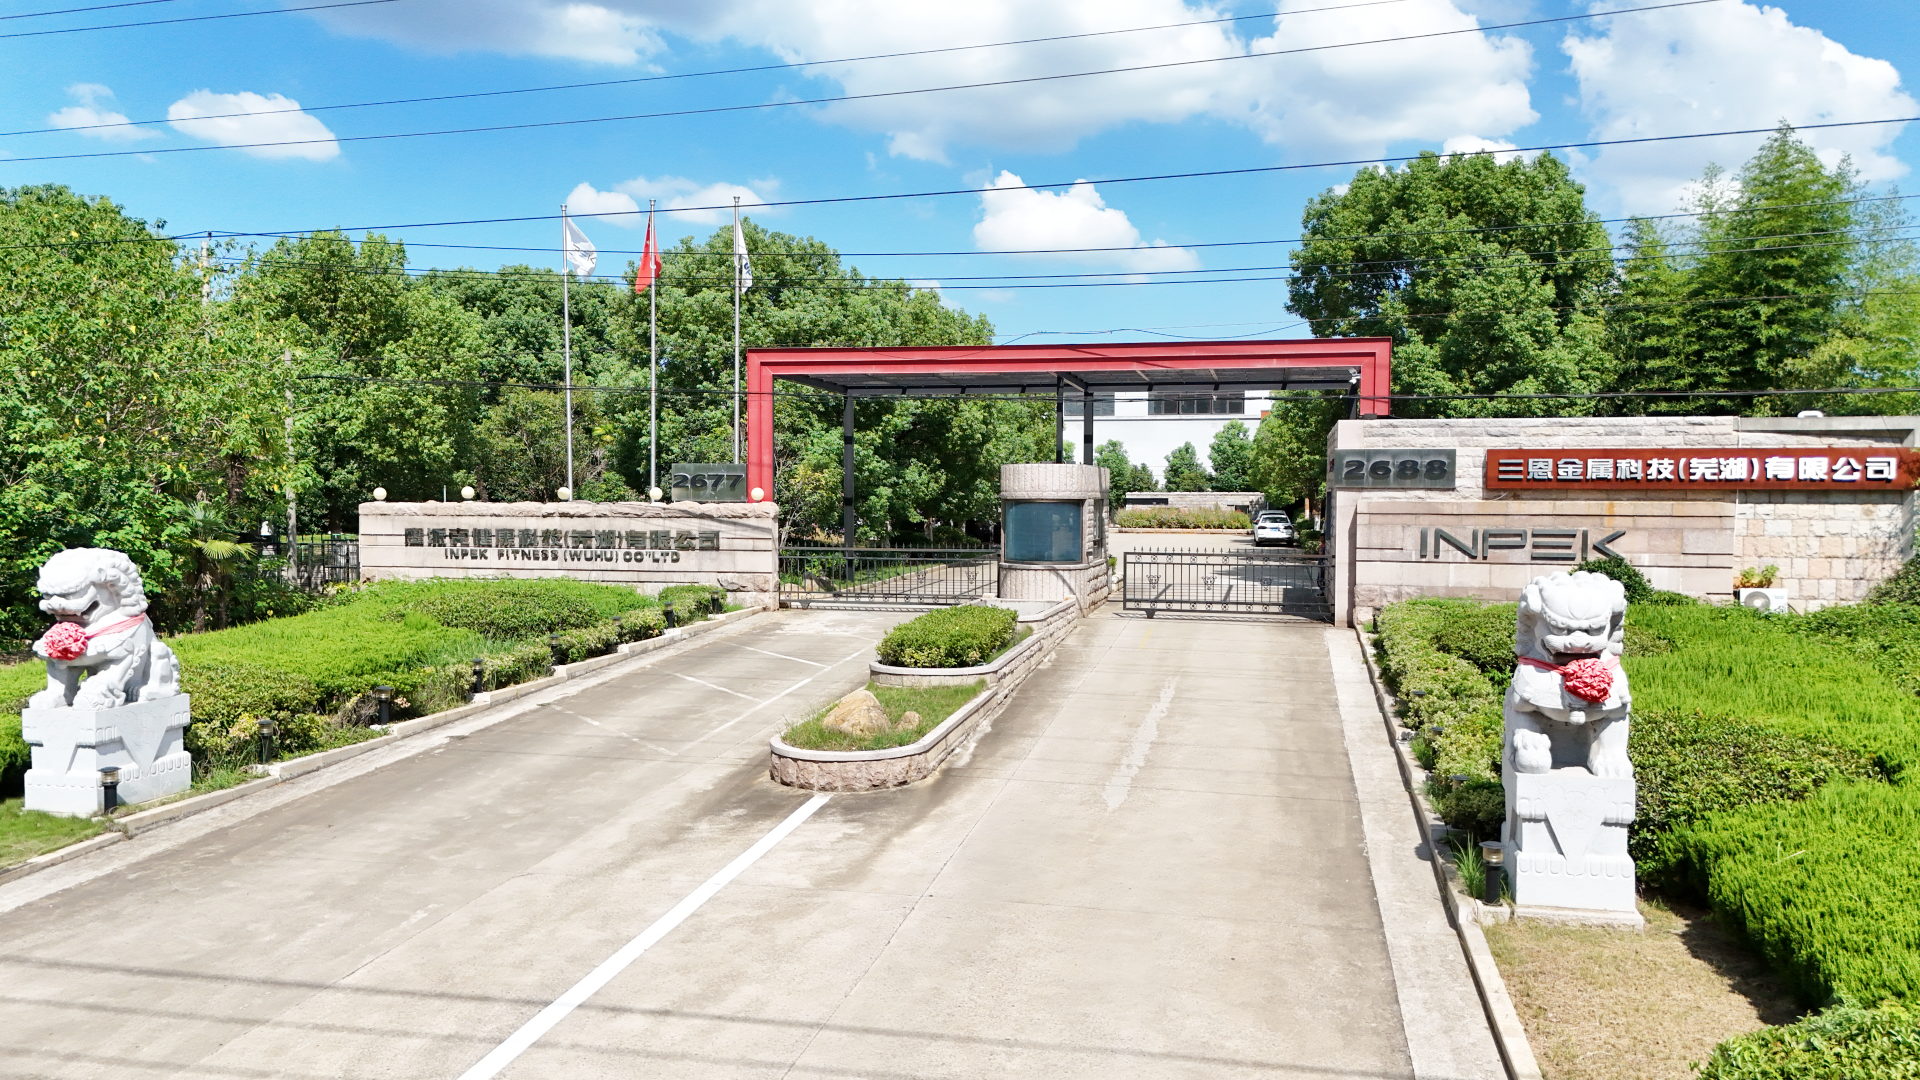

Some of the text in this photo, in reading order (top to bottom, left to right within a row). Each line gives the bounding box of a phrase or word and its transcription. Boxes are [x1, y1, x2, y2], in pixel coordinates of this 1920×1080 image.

[1343, 459, 1447, 480] 2688
[1498, 457, 1897, 481] 三恩金属科技(芜湖)有限公司
[673, 473, 744, 490] 2677
[1420, 527, 1626, 560] INPEK
[444, 548, 488, 560] INPEK
[498, 549, 559, 561] FITNESS
[563, 550, 618, 563] (WUHU)
